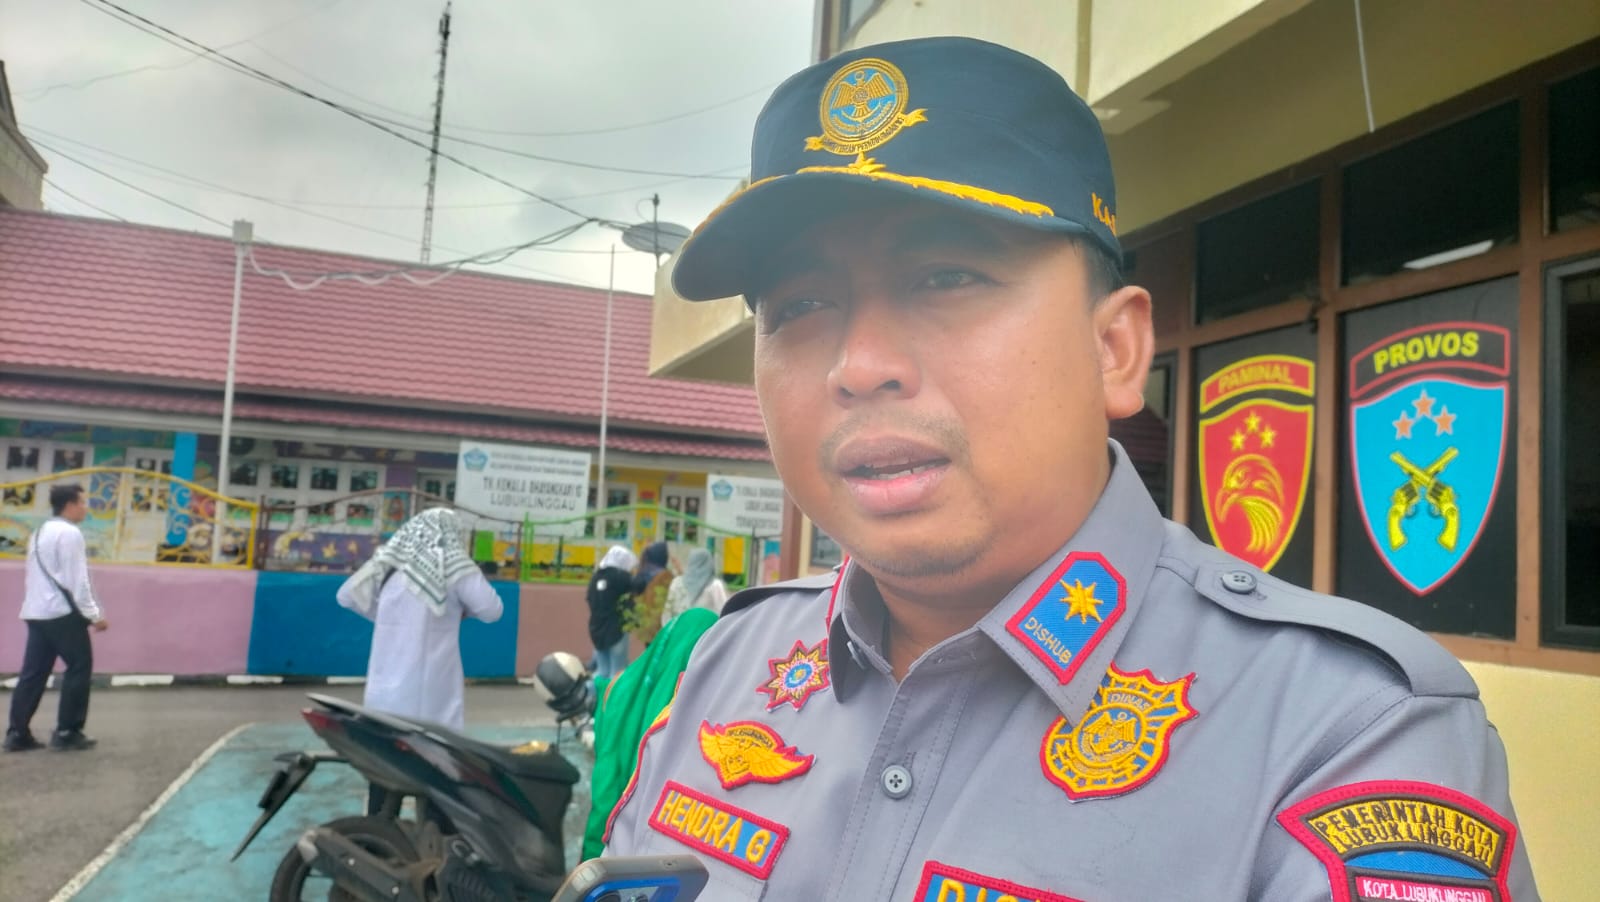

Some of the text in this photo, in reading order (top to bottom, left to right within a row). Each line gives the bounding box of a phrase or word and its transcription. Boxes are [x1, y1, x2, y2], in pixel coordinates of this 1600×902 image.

[1373, 331, 1479, 373] PROVOS
[1218, 363, 1295, 394] PAMINAL
[1023, 616, 1073, 665] DISHUB
[1109, 692, 1152, 711] DINAS
[657, 789, 771, 864] HENDRA G
[1315, 799, 1494, 847] PEMERINTAH KOTA
[1334, 820, 1493, 863] LUBUKLINGGAU
[1362, 879, 1399, 899] KOTA
